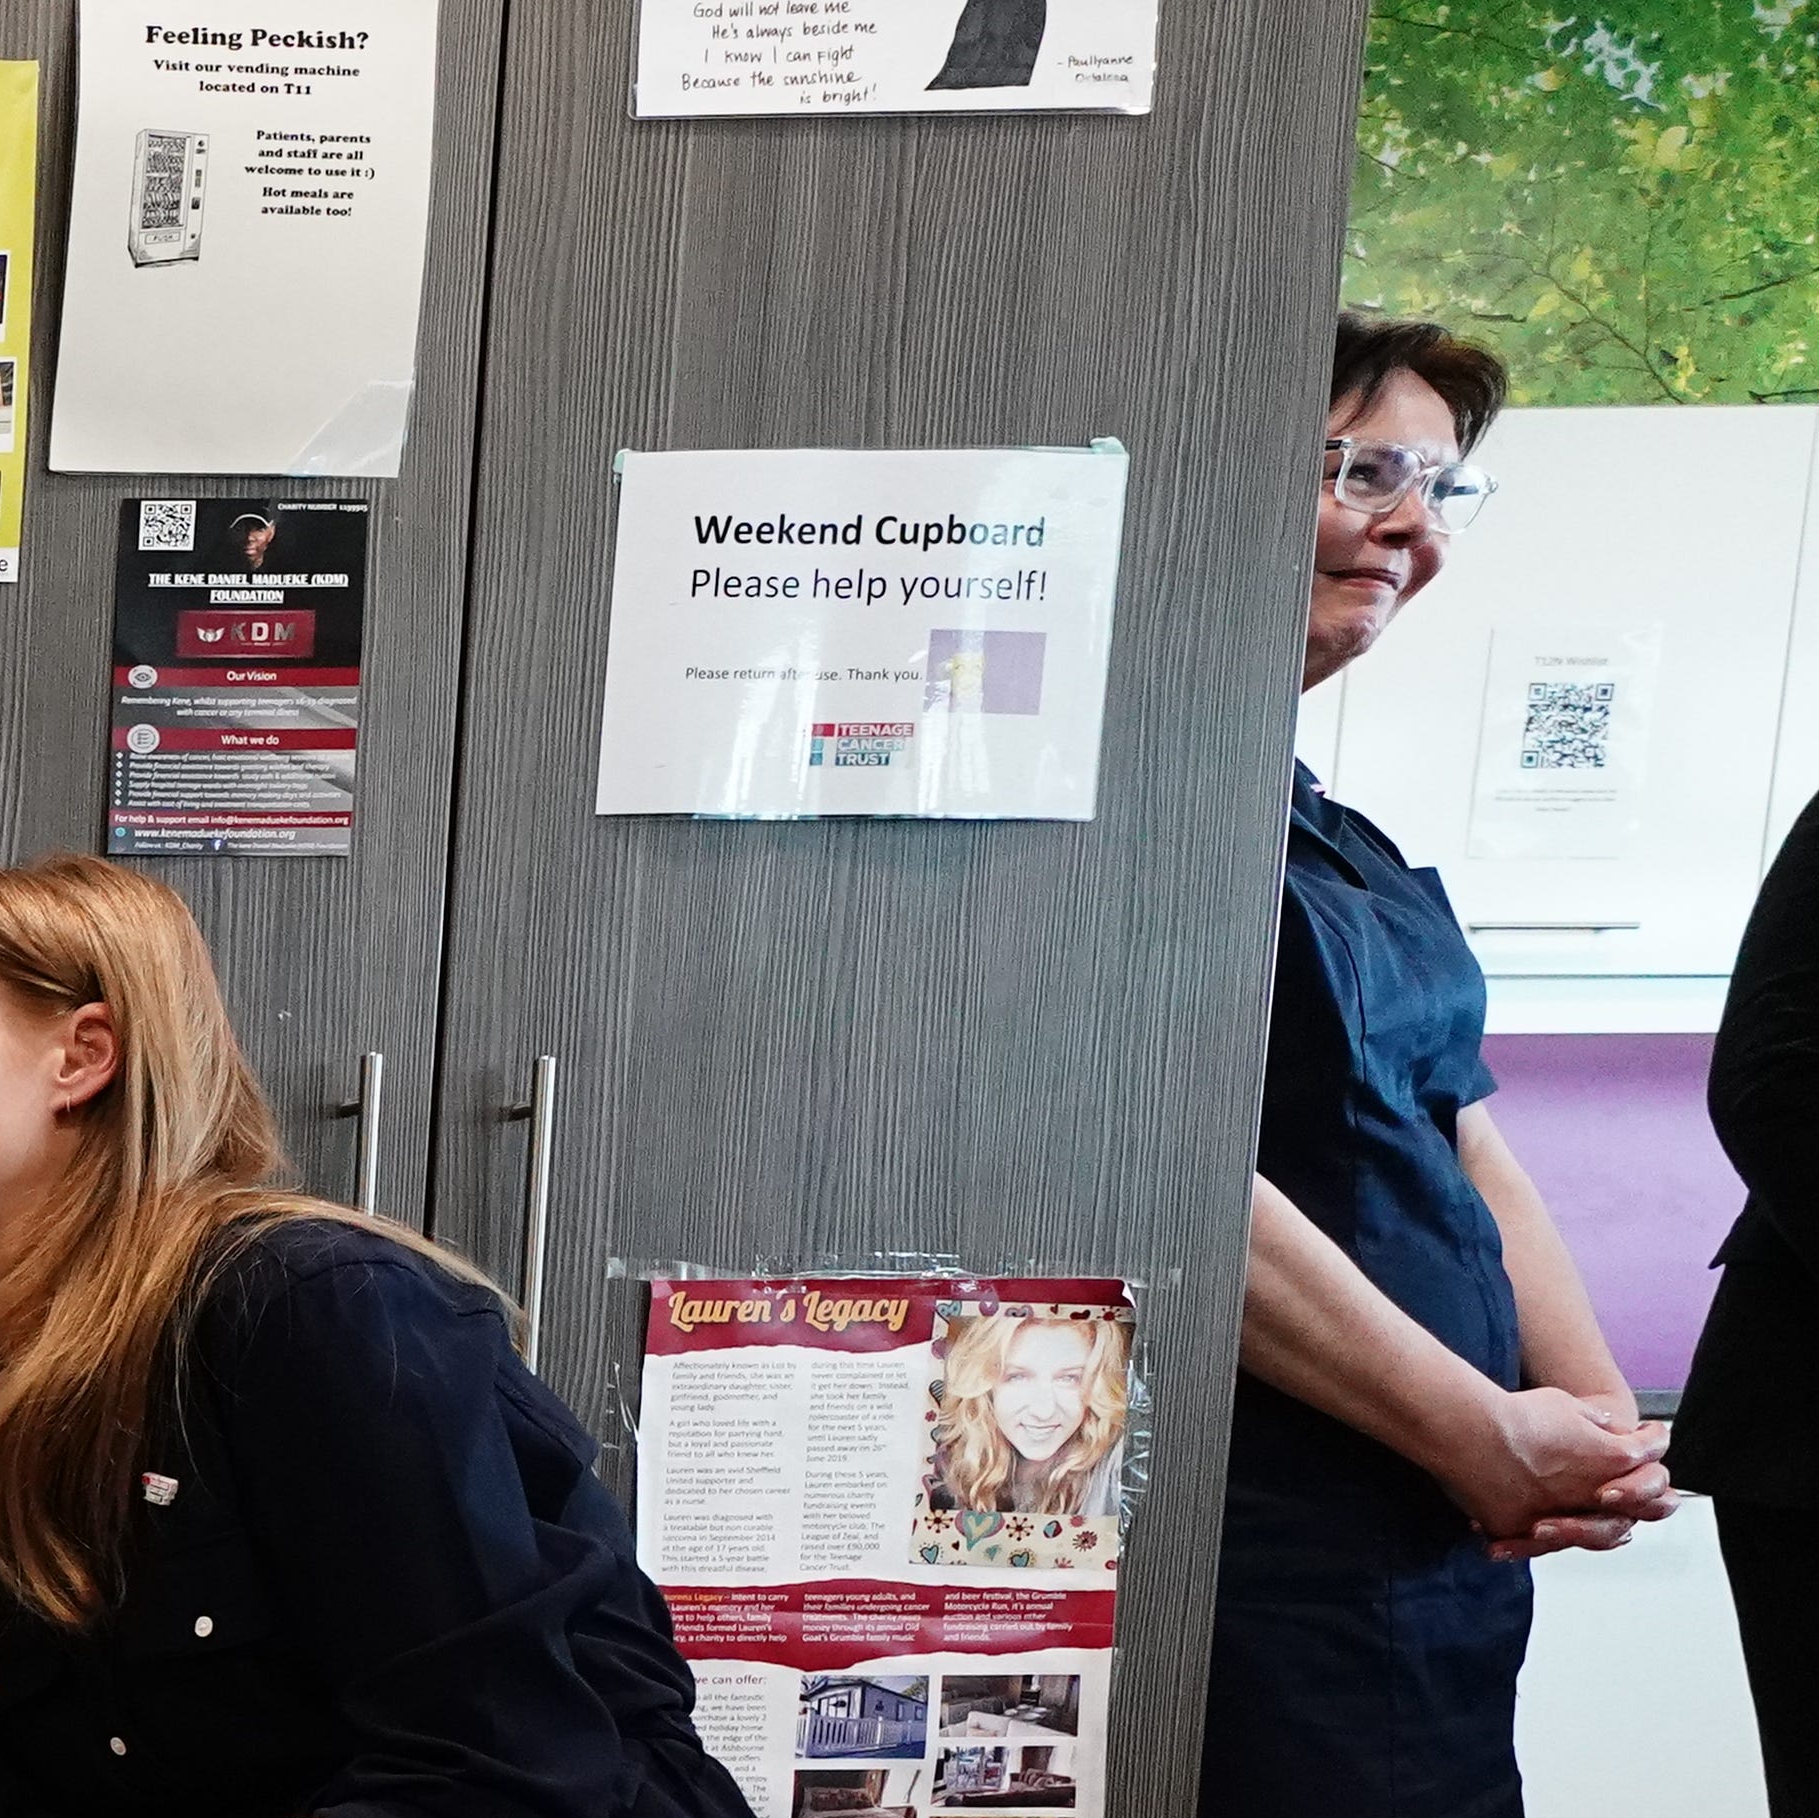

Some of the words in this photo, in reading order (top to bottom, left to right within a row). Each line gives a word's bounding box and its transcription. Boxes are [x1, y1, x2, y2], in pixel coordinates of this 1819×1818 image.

[694, 1, 722, 18] God
[729, 1, 753, 18] will
[759, 1, 778, 16] not
[824, 0, 851, 13] me
[146, 26, 243, 51] Feeling
[250, 28, 369, 50] Peckish?
[712, 23, 739, 39] He's
[746, 24, 792, 43] always
[803, 20, 849, 36] beside
[854, 22, 877, 34] me
[725, 50, 762, 63] know
[786, 53, 811, 63] can
[153, 59, 190, 72] Visit
[195, 63, 222, 73] our
[227, 63, 289, 77] vending
[294, 66, 360, 77] machine
[199, 81, 256, 93] located
[261, 84, 279, 94] on
[283, 84, 312, 95] T11
[682, 73, 740, 91] Because
[750, 71, 774, 87] the
[800, 90, 812, 104] is
[822, 83, 877, 106] bright!
[256, 131, 316, 143] Patients,
[319, 134, 371, 144] parents
[258, 149, 283, 158] and
[287, 149, 318, 159] staff
[320, 150, 344, 160] are
[347, 150, 365, 160] all
[244, 164, 303, 176] welcome
[308, 166, 321, 176] to
[325, 168, 347, 178] use
[351, 168, 361, 178] it
[262, 187, 286, 197] Hot
[291, 189, 329, 199] meals
[332, 190, 354, 200] are
[261, 205, 321, 216] available
[326, 206, 352, 216] too!
[694, 513, 864, 546] Weekend
[874, 514, 1046, 552] Cupboard
[148, 573, 172, 587] THE
[175, 573, 206, 587] KENE
[208, 573, 248, 587] DANIEL
[251, 573, 309, 587] MADUEKE
[311, 573, 349, 587] (KDM)
[691, 567, 801, 599] Please
[813, 567, 888, 606] help
[899, 569, 1048, 606] yourself!
[210, 589, 284, 603] FOUNDATION
[230, 622, 297, 641] KDM
[227, 671, 246, 682] Our
[247, 671, 277, 682] Vision
[685, 667, 730, 680] Please
[734, 668, 776, 680] return
[816, 670, 842, 681] use.
[847, 668, 890, 681] Thank
[894, 669, 923, 683] you.
[839, 724, 914, 737] TEENAGE
[221, 735, 248, 745] What
[250, 737, 264, 746] we
[266, 735, 280, 746] do
[838, 738, 905, 751] CANCER
[837, 753, 890, 766] TRUST
[115, 814, 127, 823] For
[129, 814, 146, 825] help
[148, 815, 154, 824] &
[156, 815, 186, 826] support
[188, 816, 209, 825] email
[669, 1291, 797, 1333] Lauren's
[803, 1291, 909, 1332] Legacy
[712, 1676, 733, 1685] can
